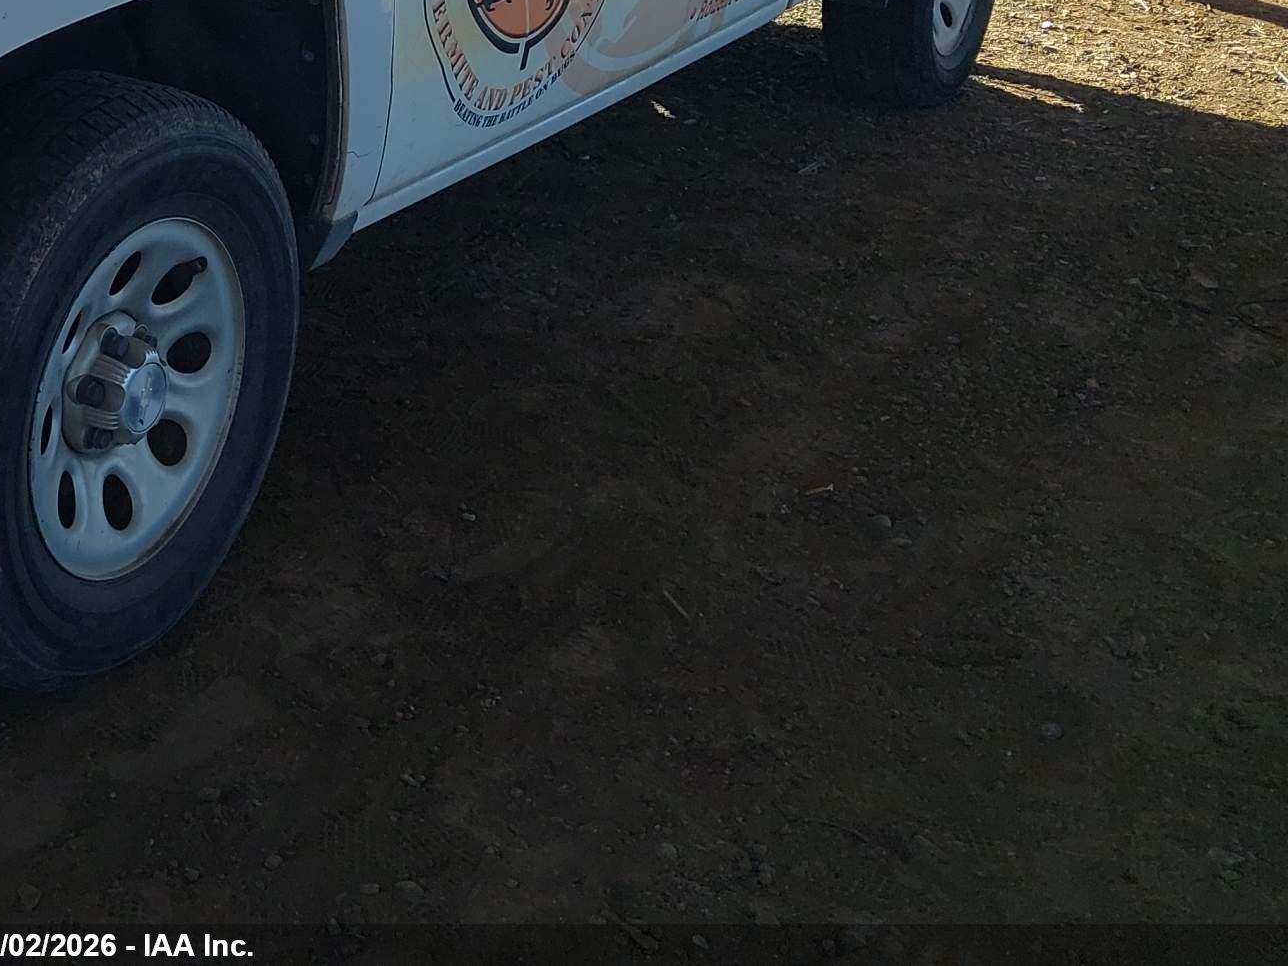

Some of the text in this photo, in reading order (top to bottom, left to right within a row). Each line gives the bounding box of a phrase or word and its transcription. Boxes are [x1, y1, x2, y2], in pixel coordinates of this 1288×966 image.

[453, 97, 482, 128] BEATING
[481, 114, 500, 128] THE
[497, 94, 535, 124] BATTLE
[534, 81, 549, 100] ON
[474, 85, 508, 111] AND
[508, 56, 557, 107] PEST
